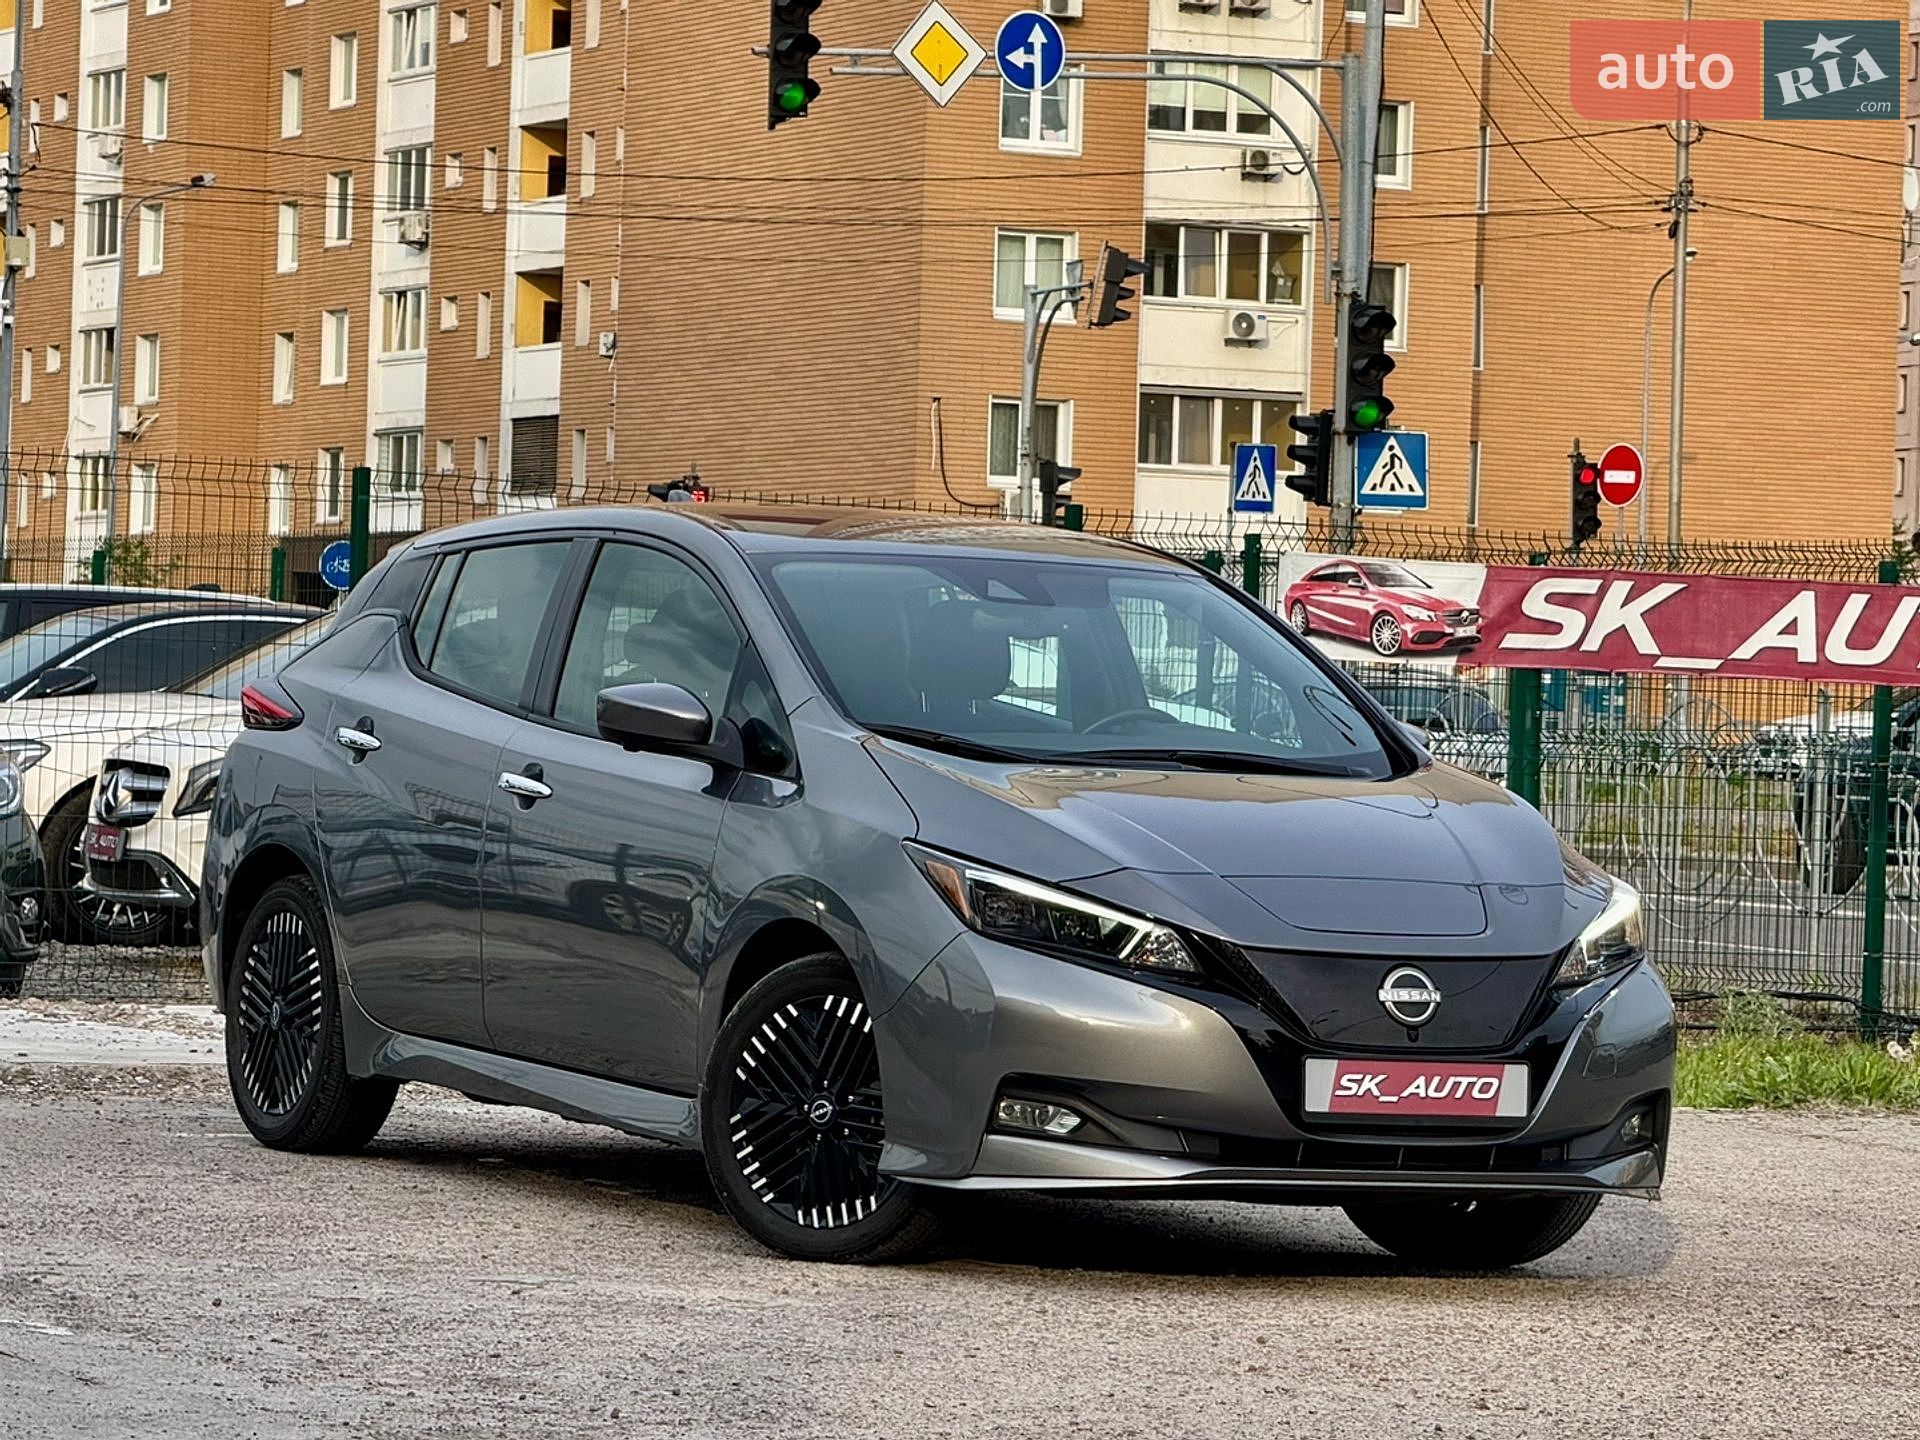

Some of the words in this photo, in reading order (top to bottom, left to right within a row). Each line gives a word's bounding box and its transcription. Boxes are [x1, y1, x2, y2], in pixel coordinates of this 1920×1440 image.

[1497, 577, 1920, 670] SK_AU
[1379, 989, 1441, 1002] NISSAN
[1334, 1073, 1499, 1103] SK_AUTO
